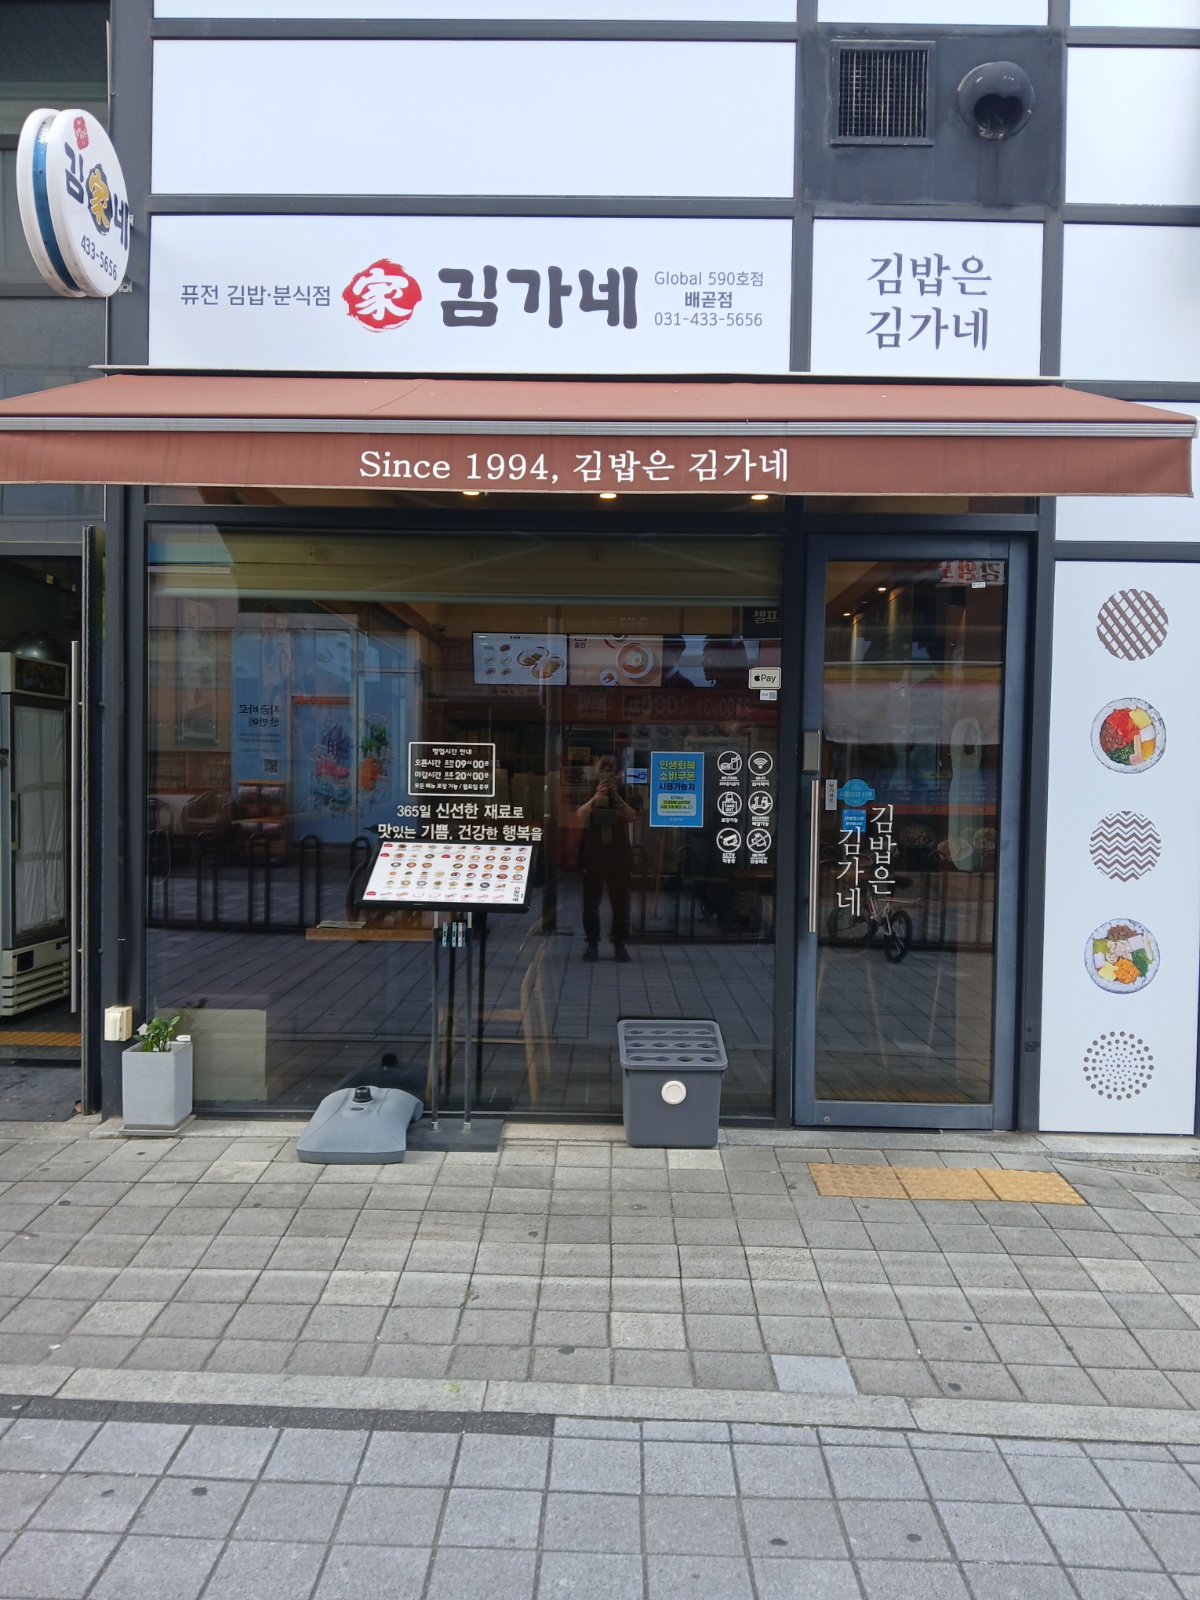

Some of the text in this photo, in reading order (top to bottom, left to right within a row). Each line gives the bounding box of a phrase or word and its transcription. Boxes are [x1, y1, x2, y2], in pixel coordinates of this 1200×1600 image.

[81, 235, 117, 281] 433-5656
[654, 271, 764, 287] Global 590호점
[867, 252, 992, 297] 김밥은
[180, 284, 331, 307] 퓨전 김밥·분식점
[348, 263, 417, 326] 家
[438, 265, 638, 329] 김가네
[684, 291, 733, 309] 배곧점
[654, 311, 763, 327] 031-433-5656
[866, 306, 988, 351] 김가네
[359, 448, 788, 484] Since 1994, 김밥은 김가네
[760, 674, 776, 684] Pay
[432, 748, 457, 756] 영업시간
[414, 759, 442, 768] 오픈시간
[659, 760, 696, 770] 민생회복
[414, 771, 442, 780] 마감시간
[659, 771, 696, 781] 소비쿠폰
[397, 803, 524, 820] 365일 신선한 재료로
[378, 823, 543, 841] 맛있는 기쁨, 건강한 행복을
[868, 804, 897, 895] 김밥은
[836, 826, 864, 917] 김가네
